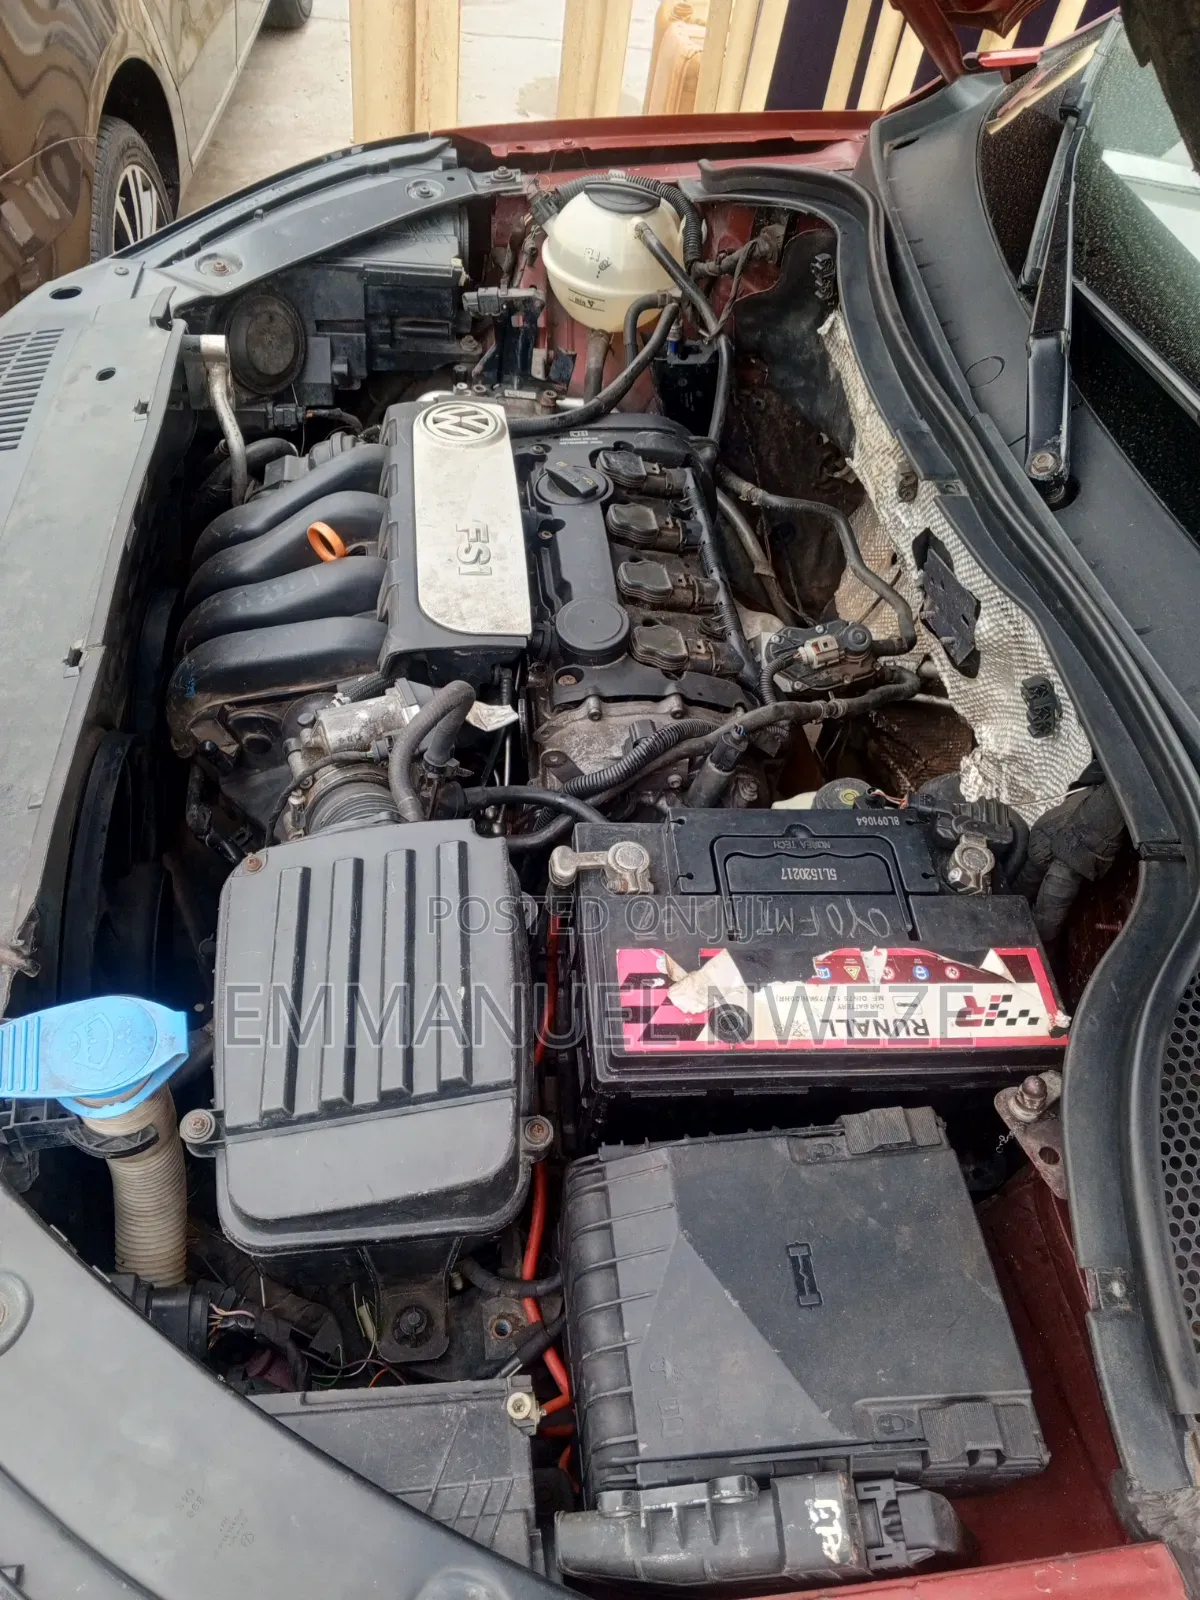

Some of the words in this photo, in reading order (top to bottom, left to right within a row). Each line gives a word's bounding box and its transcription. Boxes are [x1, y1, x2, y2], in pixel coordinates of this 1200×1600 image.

[456, 522, 493, 577] FSI
[855, 815, 900, 827] 8L091064
[772, 840, 797, 850] TECH
[780, 867, 838, 881] 5L1520217
[819, 1018, 930, 1038] RUNALL
